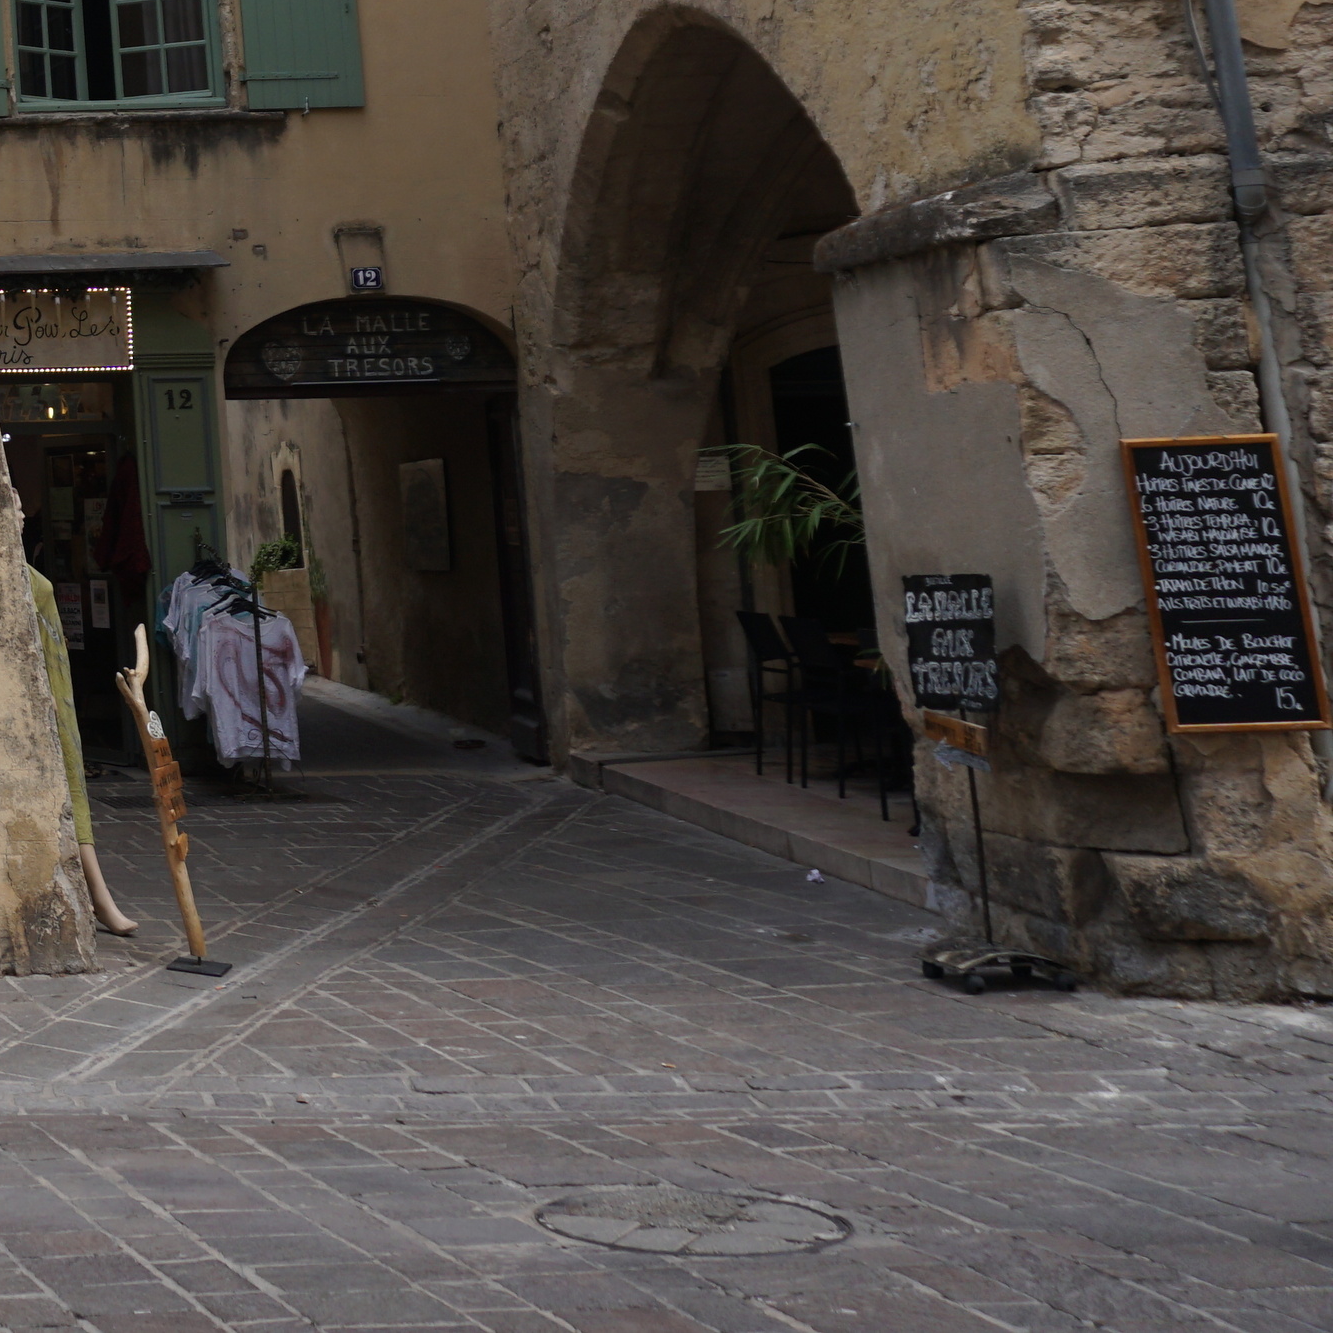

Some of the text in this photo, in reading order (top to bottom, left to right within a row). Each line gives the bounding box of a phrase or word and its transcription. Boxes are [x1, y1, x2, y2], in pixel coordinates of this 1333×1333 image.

[357, 270, 377, 286] 12
[302, 313, 431, 336] LA MALLE
[347, 336, 392, 355] AUX
[327, 356, 434, 377] TRESORS
[164, 389, 193, 410] 12
[1160, 449, 1258, 476] AUJOURD'HUI
[1212, 479, 1227, 490] DE
[1198, 497, 1239, 511] NATURE
[1150, 545, 1162, 559] 3
[1209, 544, 1241, 557] SALSA
[1208, 576, 1245, 591] THON
[905, 587, 993, 623] LA MALLE
[932, 628, 974, 657] AUX
[1214, 636, 1238, 651] DE
[1241, 633, 1297, 649] BOUCHOT
[912, 658, 998, 699] TRESORS
[1233, 668, 1258, 683] LAIT
[1259, 669, 1277, 683] DE
[1279, 669, 1305, 681] COCO
